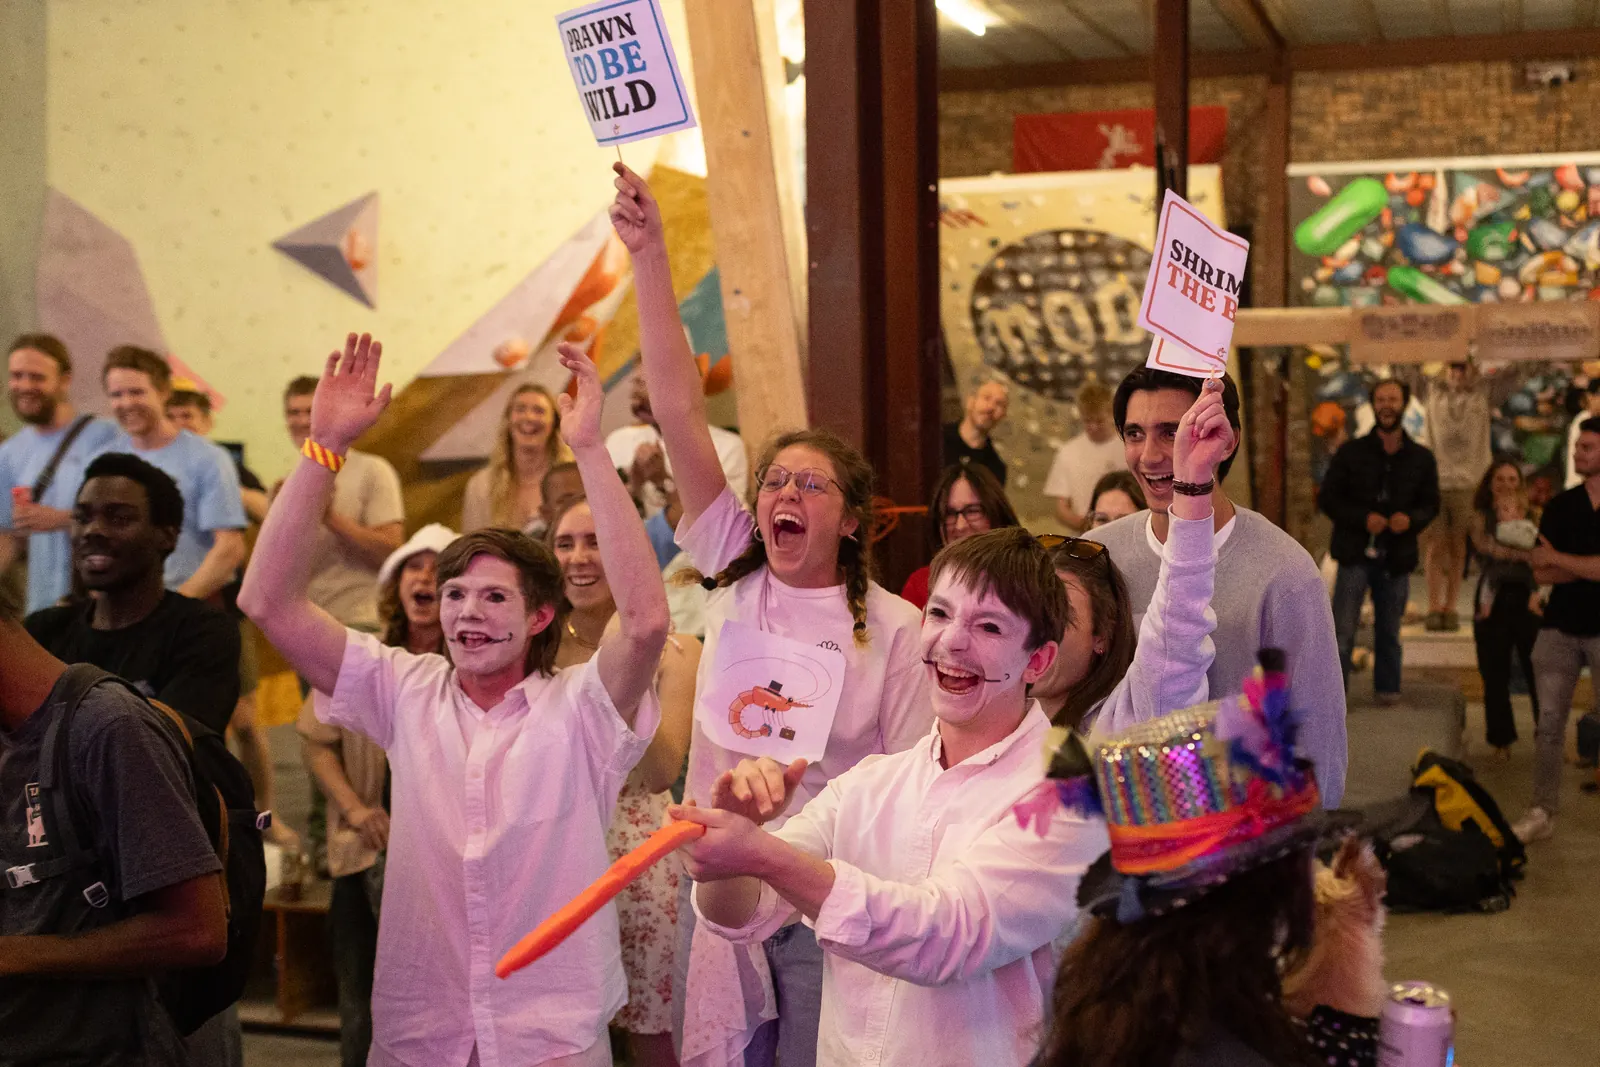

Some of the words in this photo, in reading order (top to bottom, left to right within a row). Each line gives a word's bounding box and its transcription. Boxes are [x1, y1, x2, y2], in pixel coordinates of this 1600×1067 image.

[566, 12, 637, 52] PRAWN
[573, 53, 597, 86] TO
[597, 40, 647, 80] BE
[584, 79, 657, 122] WILD
[1166, 261, 1217, 313] THE
